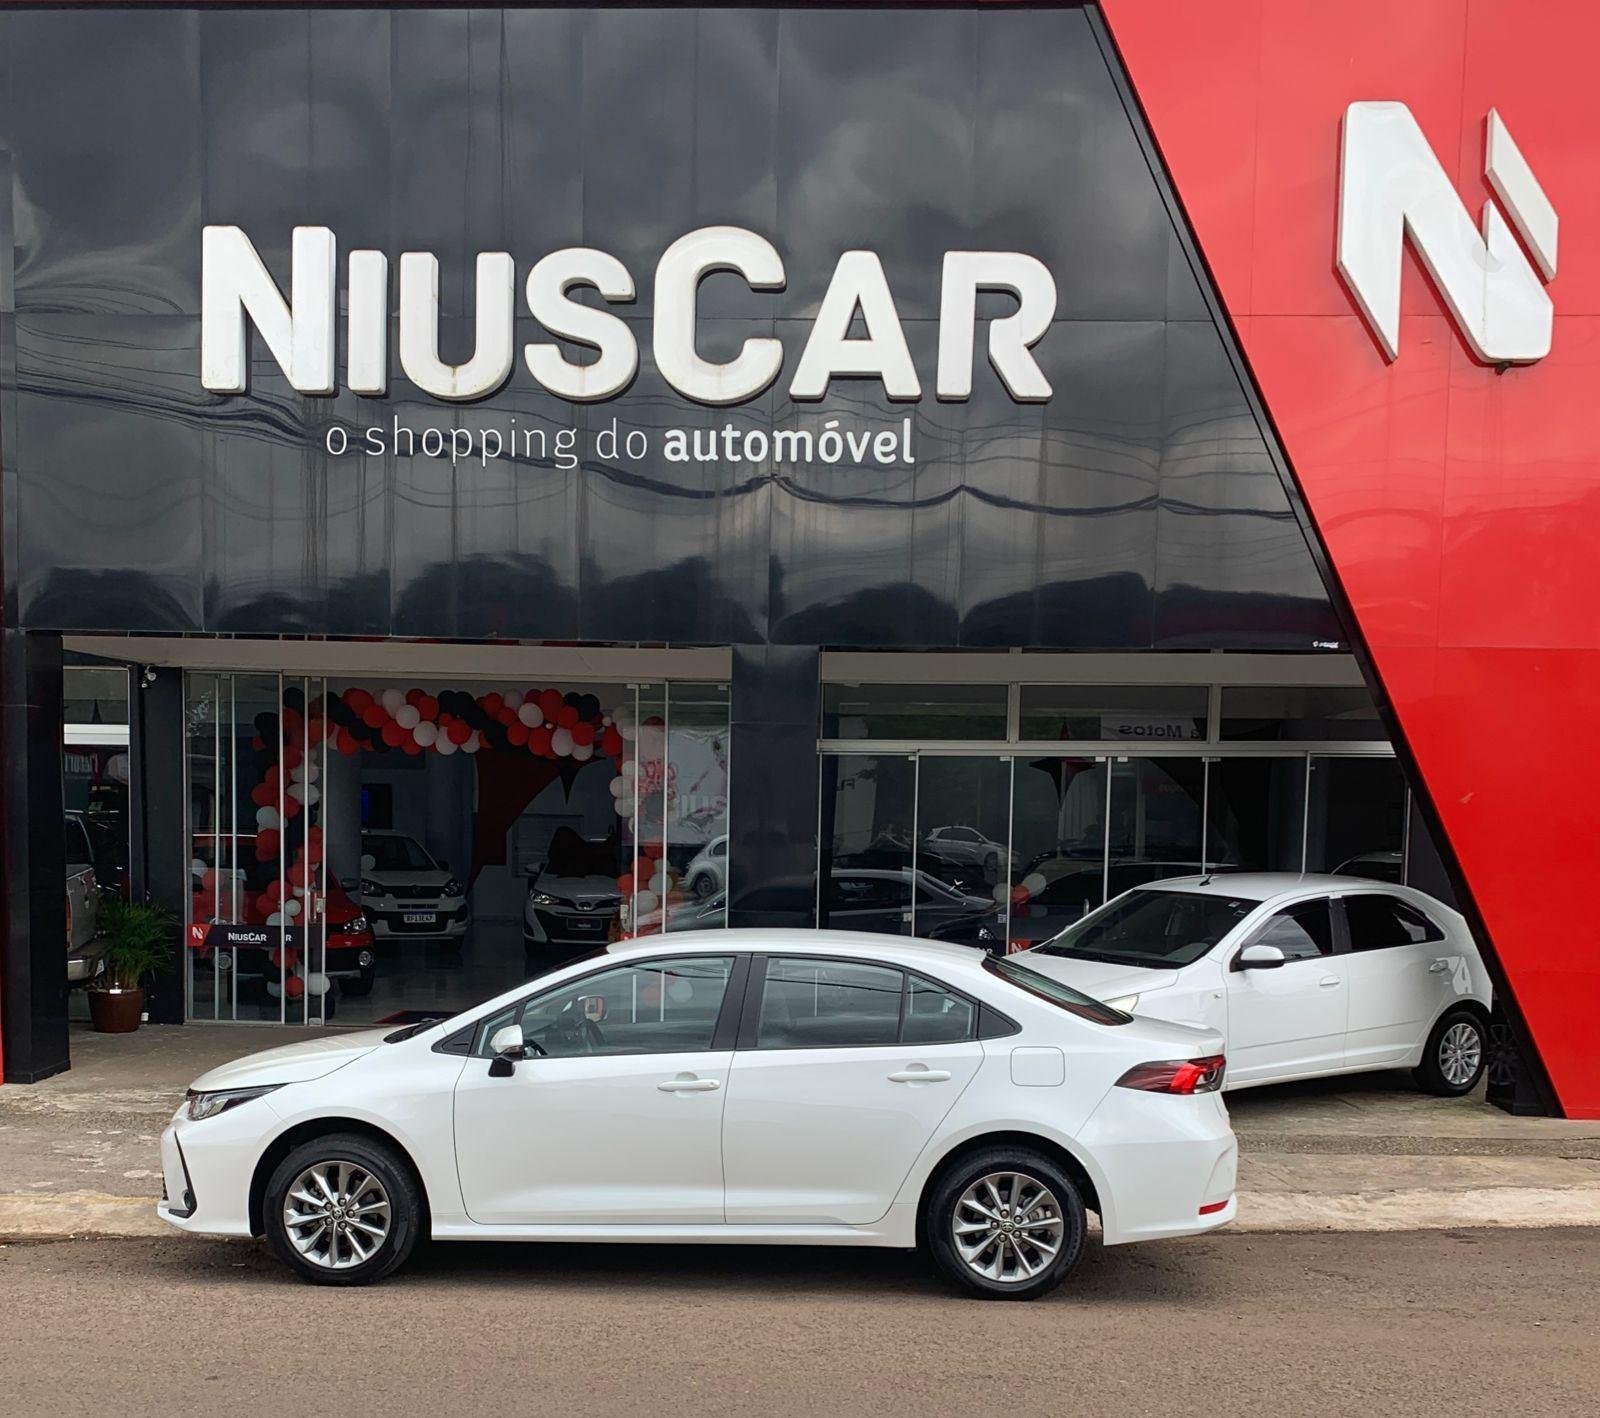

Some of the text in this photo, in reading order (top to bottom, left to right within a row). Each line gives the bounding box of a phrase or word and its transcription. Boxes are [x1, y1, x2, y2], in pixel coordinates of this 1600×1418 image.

[201, 225, 1057, 404] NIUSCAR
[326, 414, 915, 469] o shopping do automóvel
[228, 932, 267, 941] NIUSCAR
